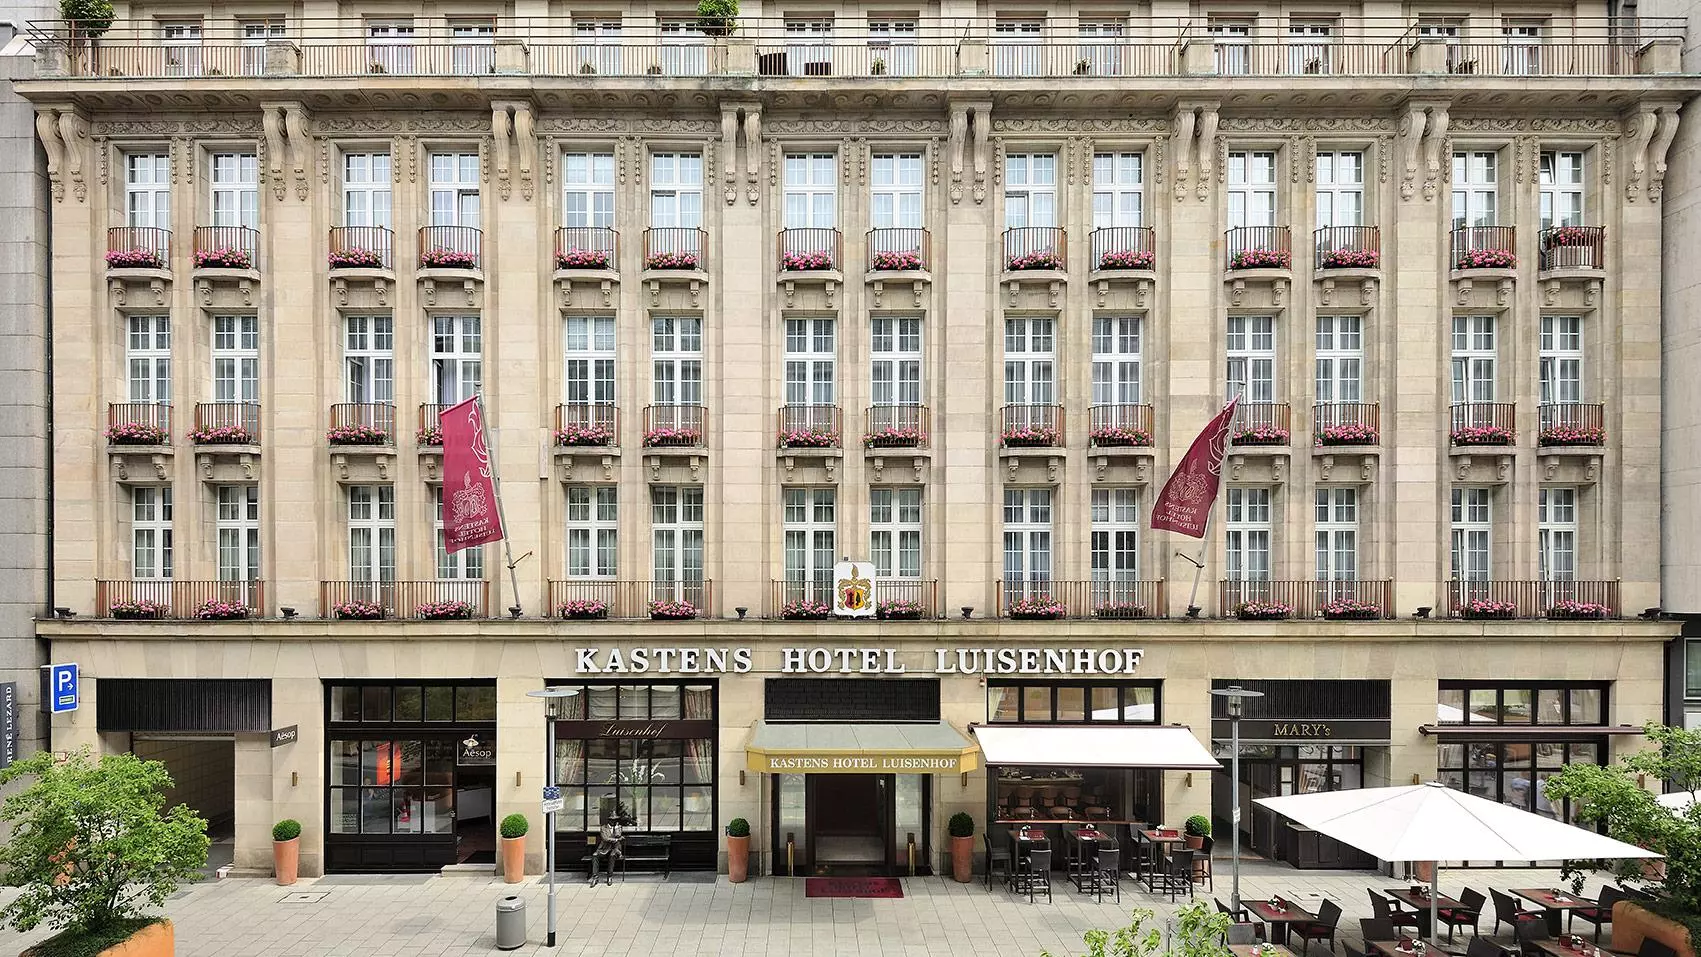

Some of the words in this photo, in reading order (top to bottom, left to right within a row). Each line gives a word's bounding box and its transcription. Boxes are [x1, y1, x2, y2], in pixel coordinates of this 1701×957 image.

[575, 648, 753, 673] KASTENS
[782, 648, 906, 673] HOTEL
[935, 648, 1145, 674] LUISENHOF
[58, 670, 72, 692] P
[5, 686, 13, 730] LEZARD
[600, 722, 669, 738] Luisenhof
[1273, 723, 1331, 736] MARY's
[770, 758, 829, 768] KASTENS
[832, 758, 878, 768] HOTEL
[882, 758, 957, 768] LUISENHOF
